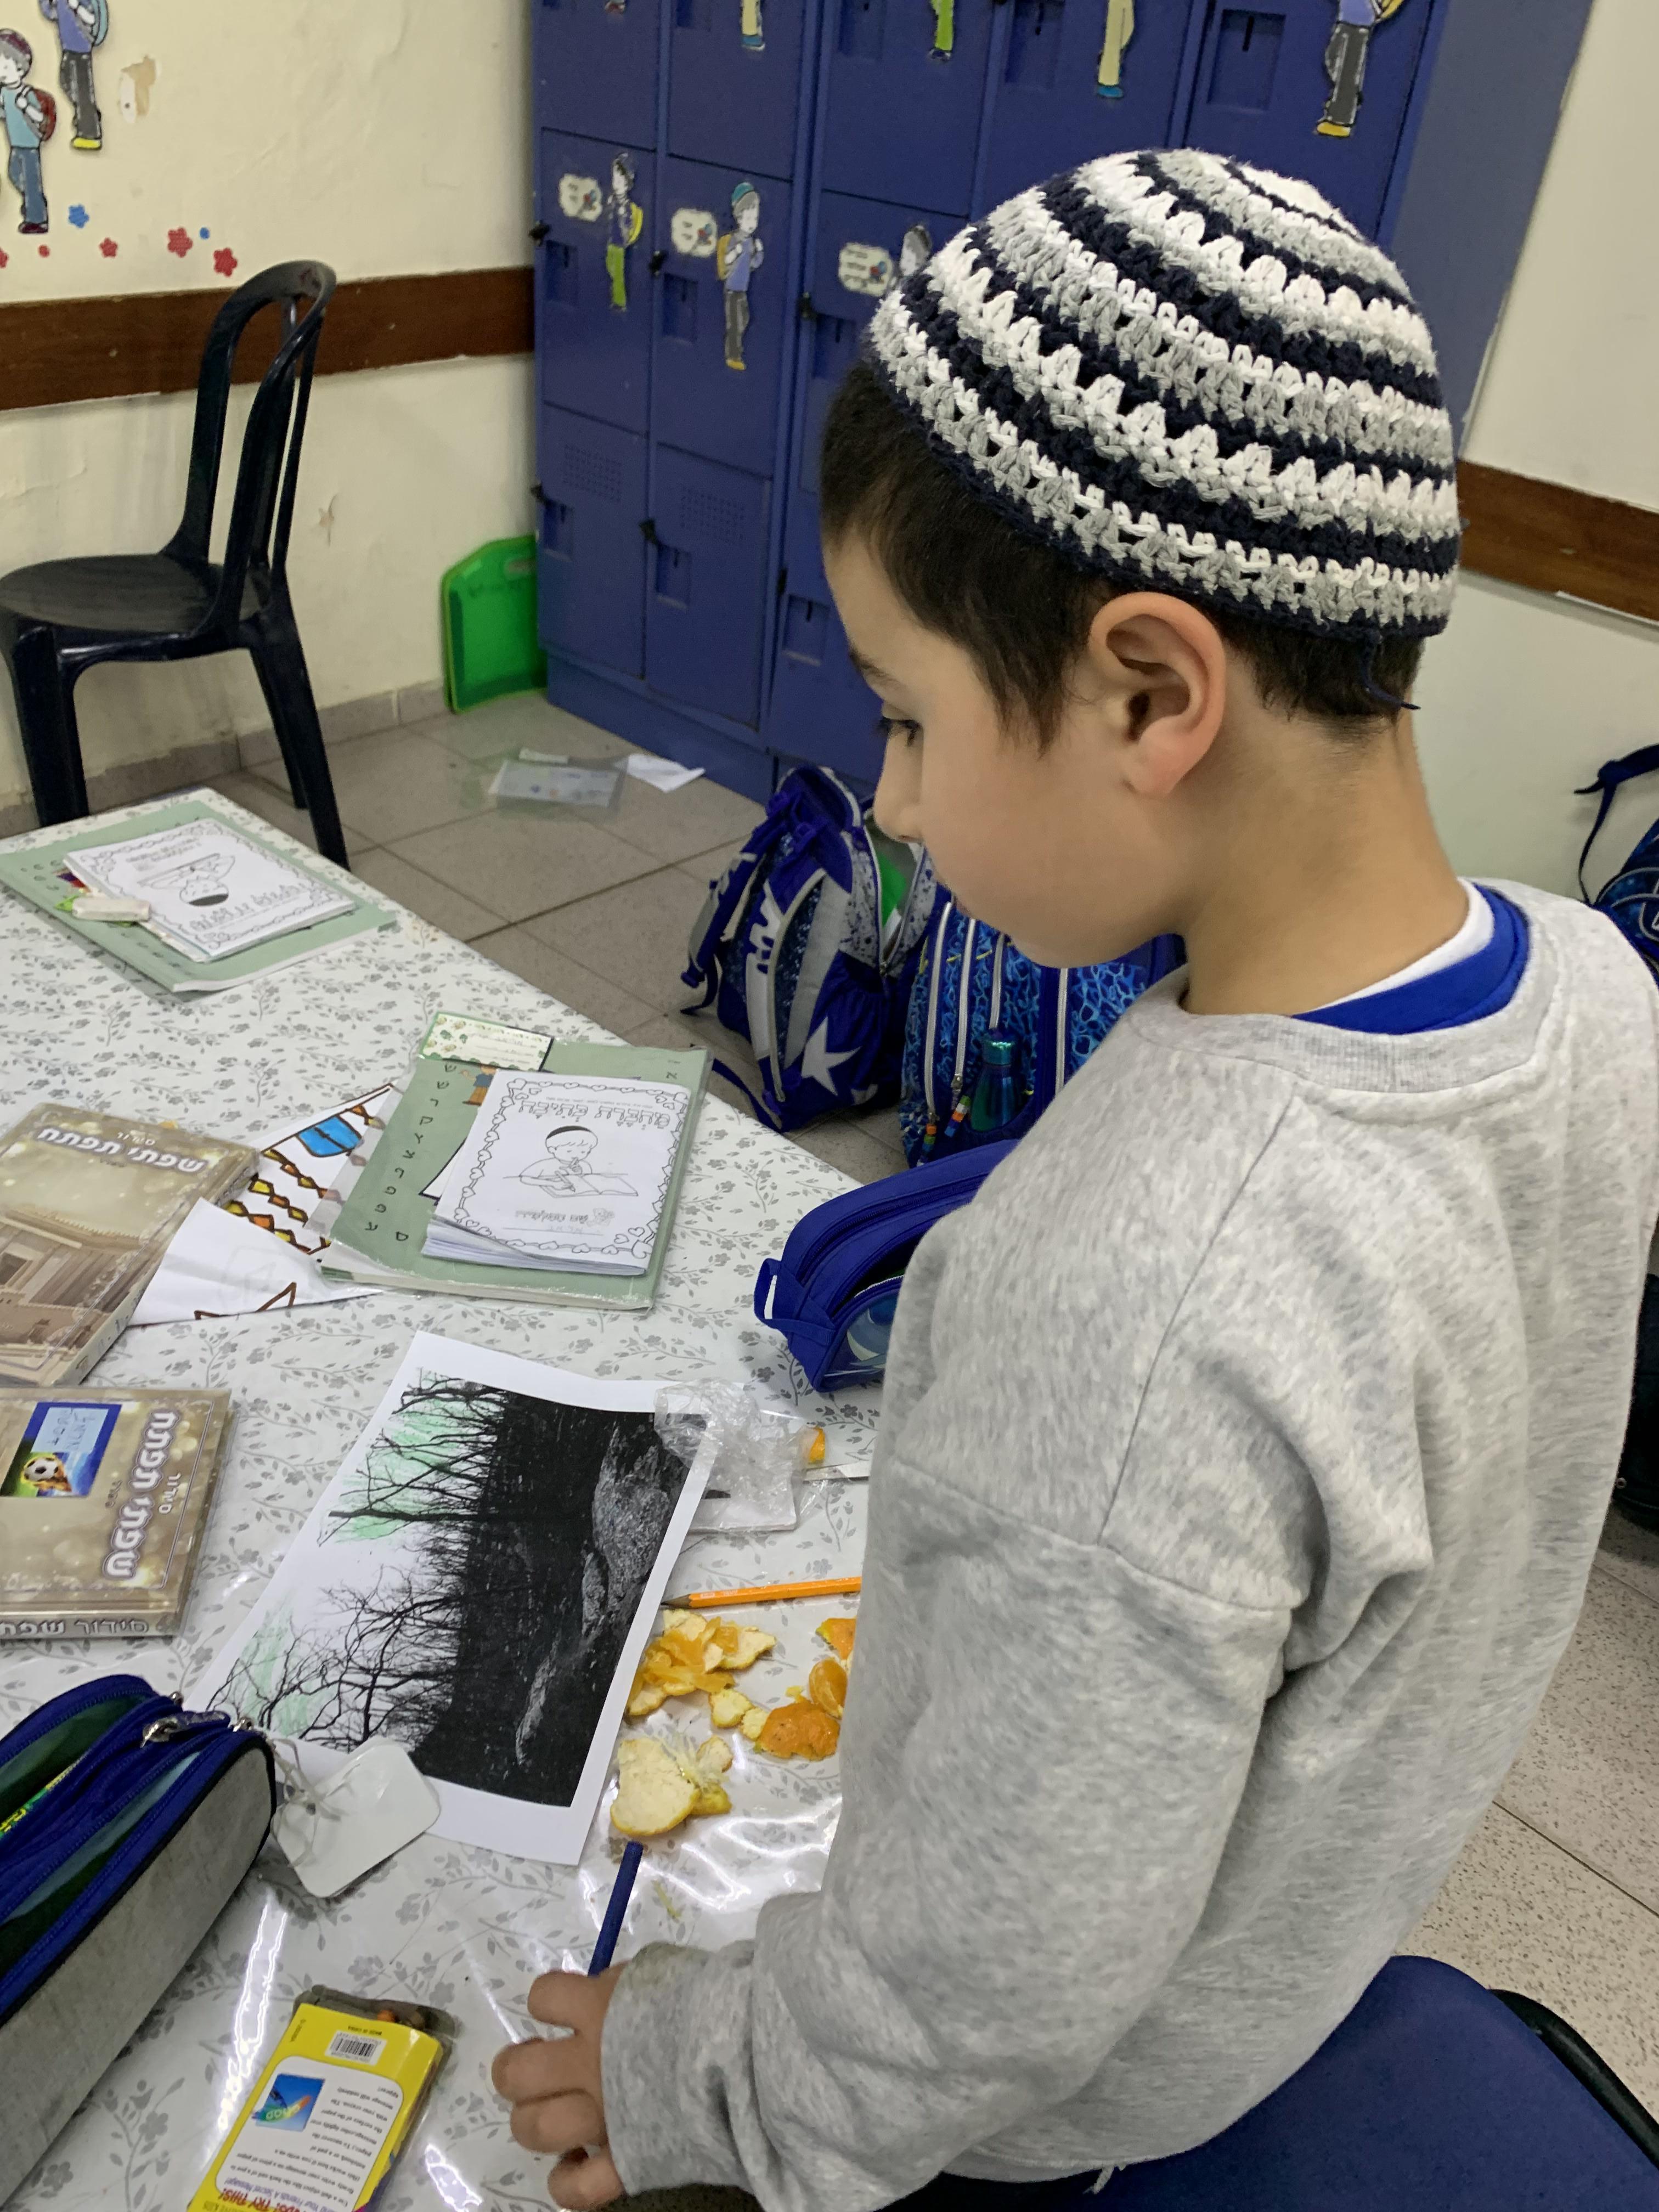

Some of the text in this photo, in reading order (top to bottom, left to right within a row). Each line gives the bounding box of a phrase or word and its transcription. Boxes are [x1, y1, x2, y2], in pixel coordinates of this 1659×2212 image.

[37, 1127, 204, 1172] שפתי תפתח
[106, 1412, 177, 1577] שפתי תפתח
[159, 1473, 181, 1514] סידור
[74, 1619, 149, 1634] סידור
[218, 2188, 249, 2206] THIS!
[248, 2197, 271, 2212] TRY
